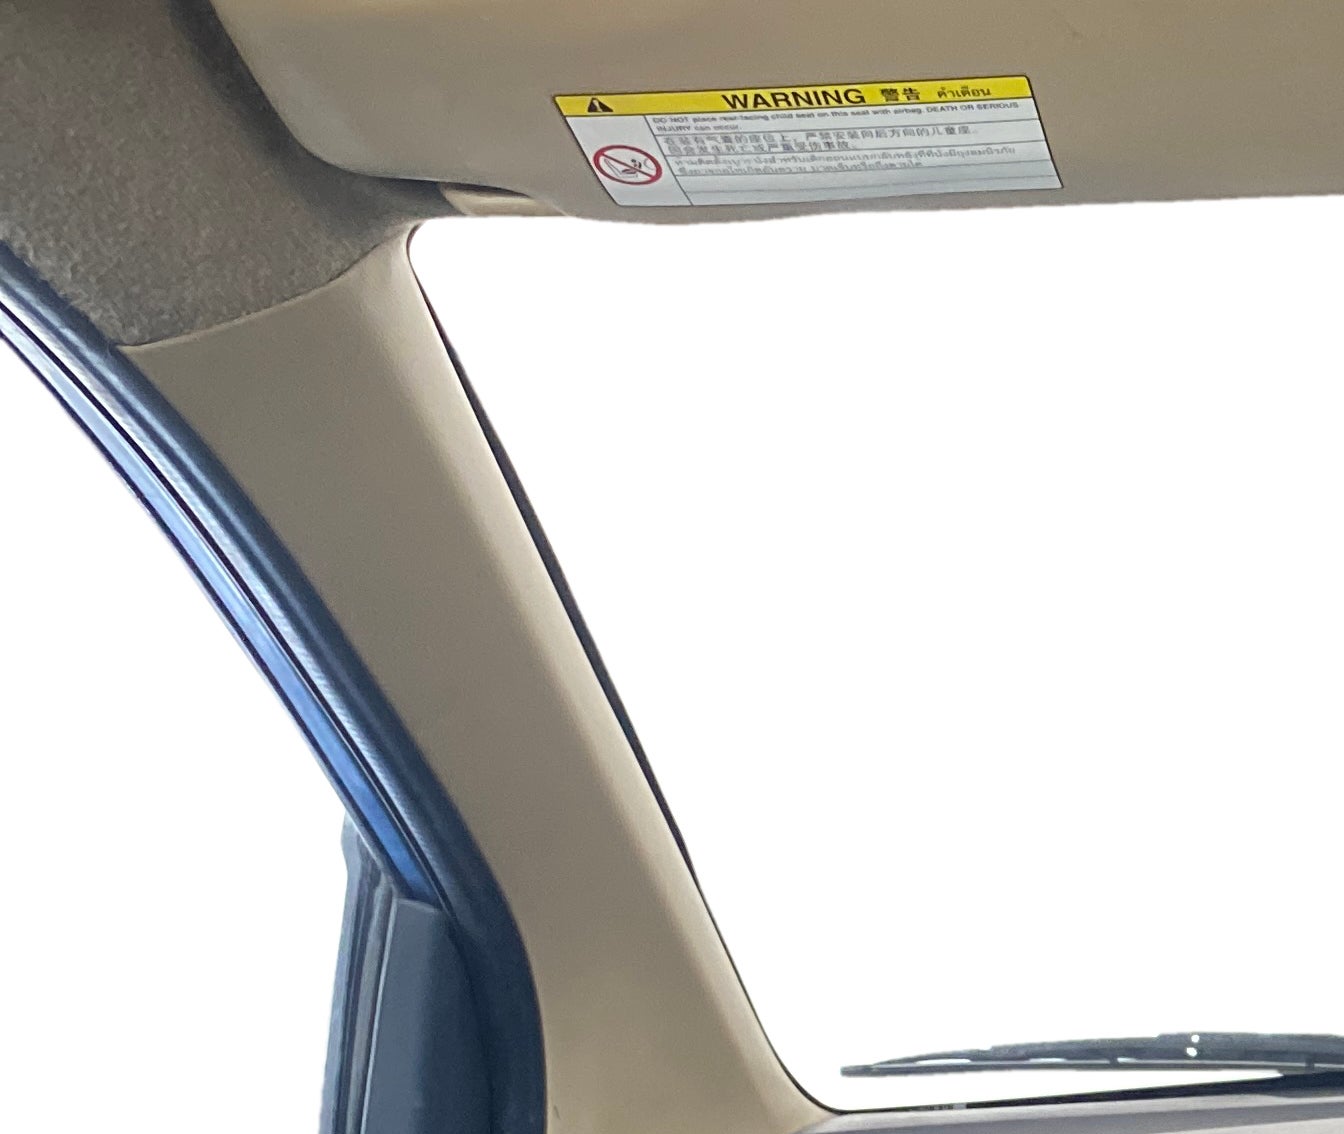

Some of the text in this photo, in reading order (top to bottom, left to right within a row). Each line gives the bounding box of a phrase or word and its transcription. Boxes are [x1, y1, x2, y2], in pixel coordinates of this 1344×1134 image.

[722, 88, 867, 110] WARNING
[880, 87, 920, 101] 警告
[926, 105, 958, 113] DEATH
